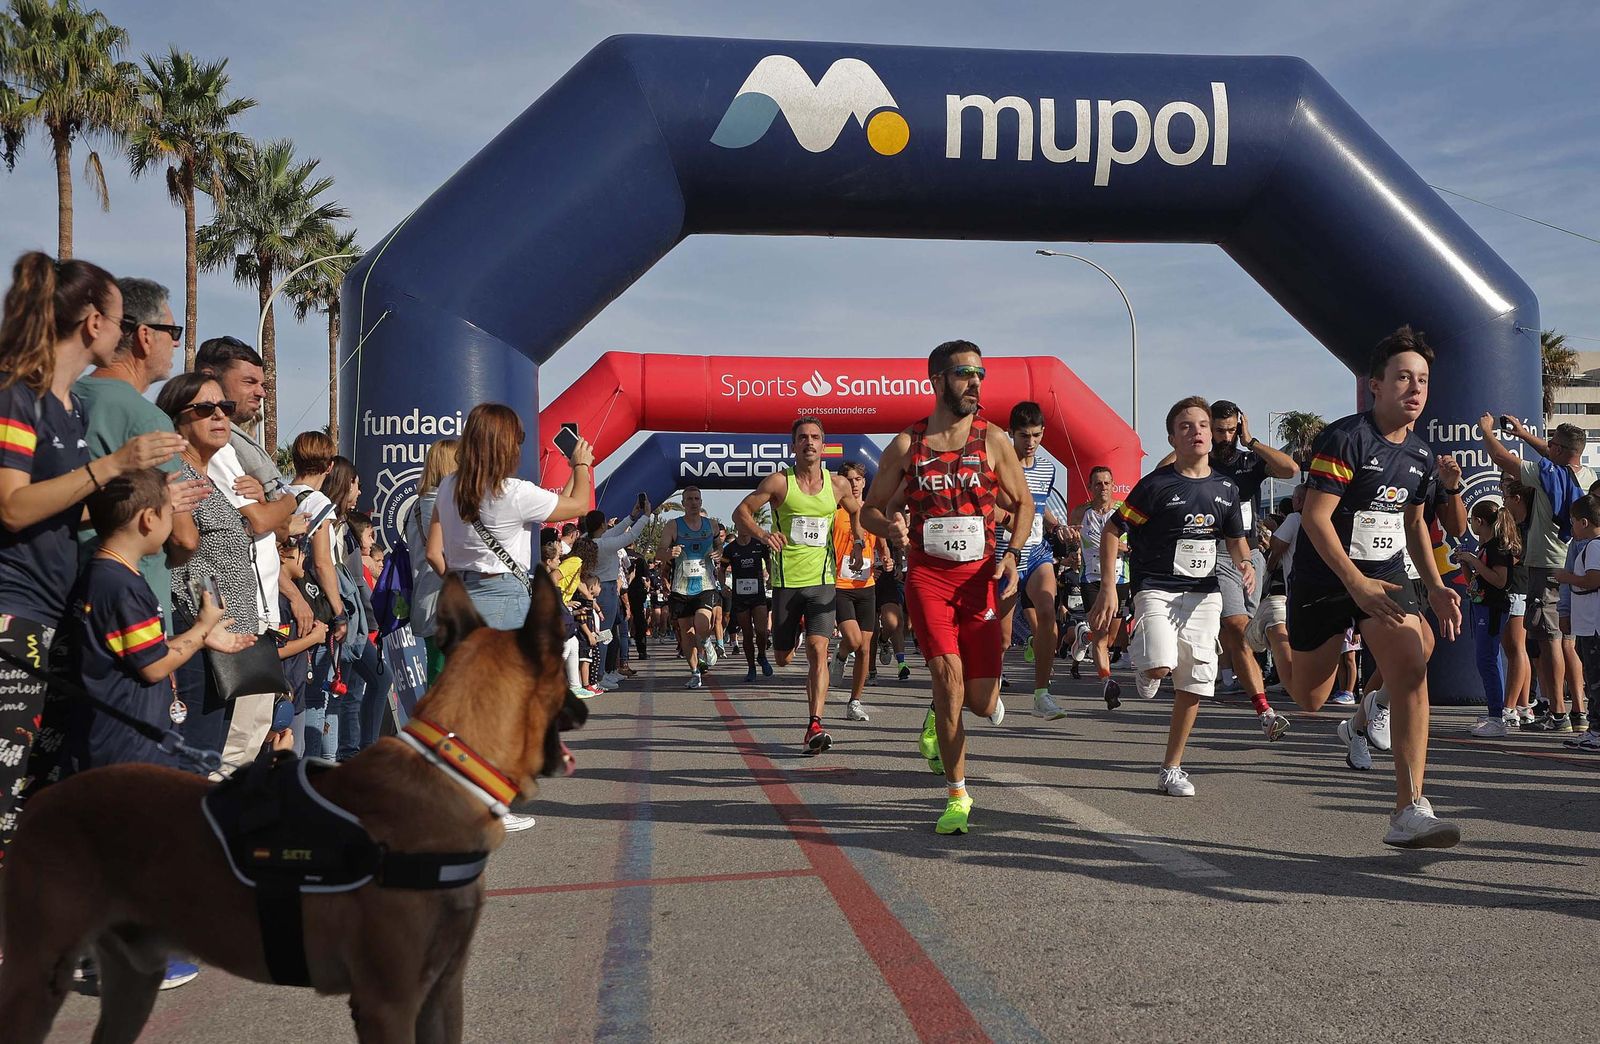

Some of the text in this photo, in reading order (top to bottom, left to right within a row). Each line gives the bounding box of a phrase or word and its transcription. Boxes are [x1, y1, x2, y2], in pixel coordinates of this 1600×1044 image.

[946, 82, 1229, 186] mupol
[721, 374, 797, 402] Sports
[797, 406, 877, 416] sportssantander.es
[362, 408, 466, 436] fundaci
[680, 443, 796, 459] POLICI
[918, 472, 982, 491] KENYA
[403, 486, 414, 496] de
[1374, 485, 1409, 503] 200
[1183, 513, 1216, 527] 200
[803, 531, 819, 540] 149
[473, 520, 495, 546] BIMBA
[496, 548, 515, 569] LOLA
[944, 540, 967, 551] 143
[1372, 537, 1393, 549] 552
[1190, 559, 1207, 569] 331
[0, 682, 42, 695] oolest
